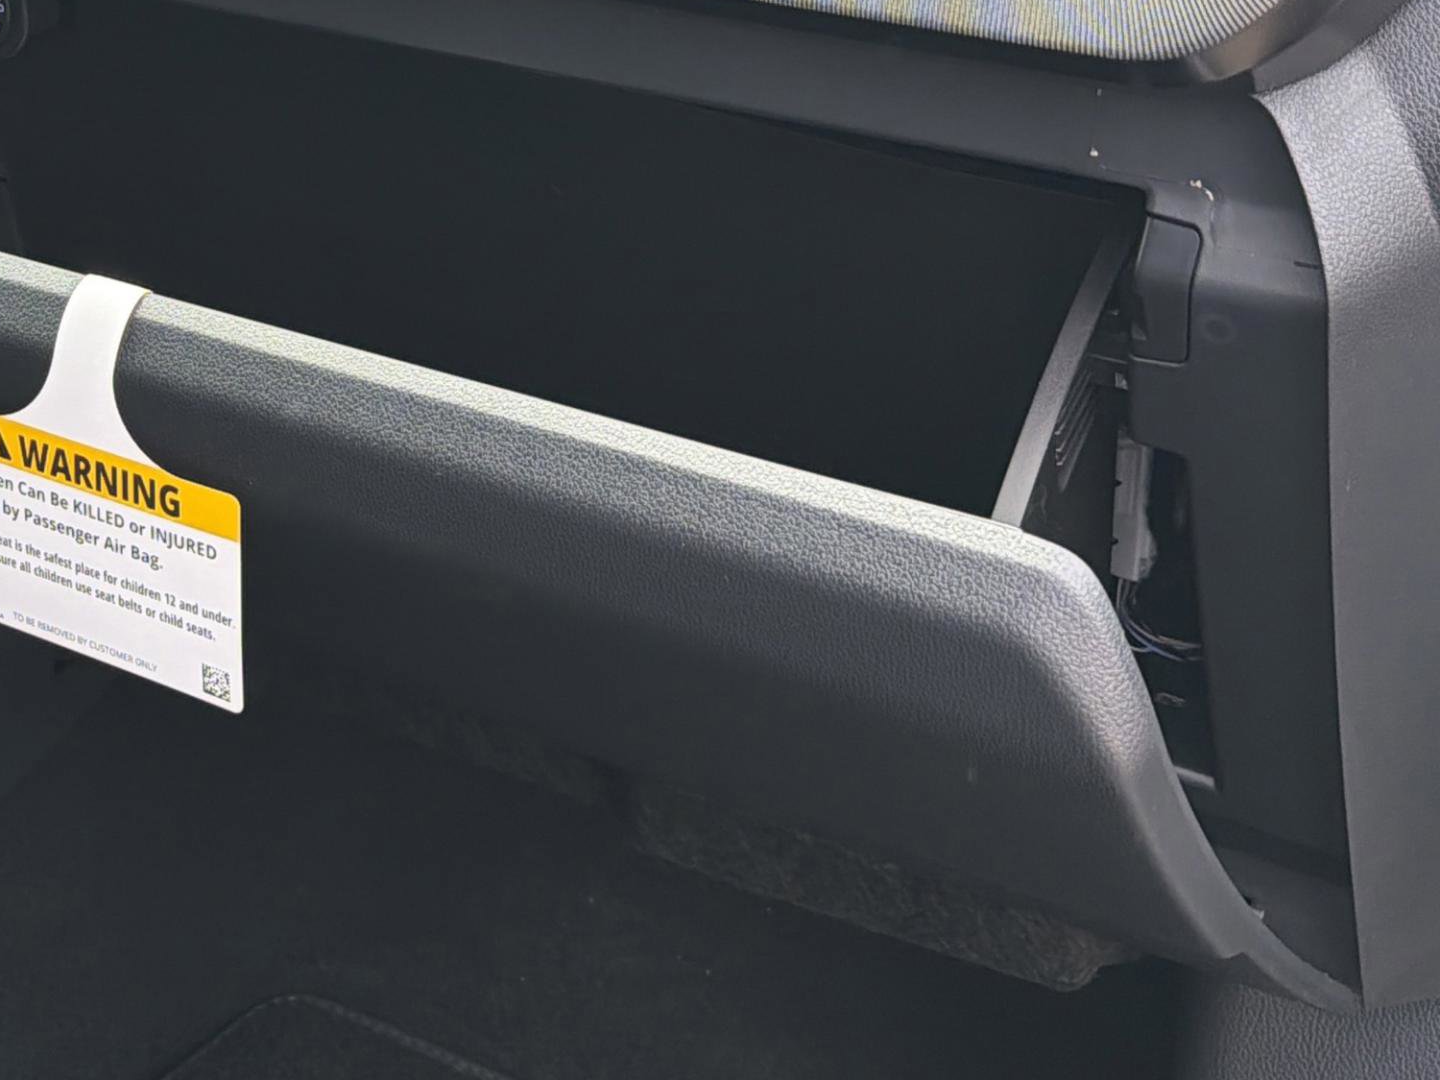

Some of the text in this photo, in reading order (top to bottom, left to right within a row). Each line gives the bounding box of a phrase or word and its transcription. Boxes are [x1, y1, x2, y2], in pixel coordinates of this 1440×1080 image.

[18, 434, 181, 519] WARNING
[2, 499, 164, 571] by Passenger Air Bag.
[17, 481, 46, 504] Can
[50, 490, 69, 511] Be
[73, 498, 125, 529] KILLED
[128, 521, 147, 537] or
[150, 527, 217, 560] INJURED
[14, 538, 23, 552] is
[25, 543, 41, 559] the
[43, 551, 72, 570] safest
[75, 562, 101, 580] place
[103, 570, 118, 586] for
[120, 577, 161, 602] children
[164, 593, 176, 607] 12
[179, 600, 199, 615] and
[201, 610, 236, 629] under.
[19, 561, 31, 574] all
[33, 565, 73, 588] children
[75, 582, 92, 596] use
[95, 588, 115, 605] seat
[118, 594, 142, 614] belts
[145, 606, 156, 619] or
[159, 610, 184, 629] child
[186, 621, 216, 642] seats.
[13, 611, 158, 672] TO BE REMOVED BY CUSTOMER ONLY
